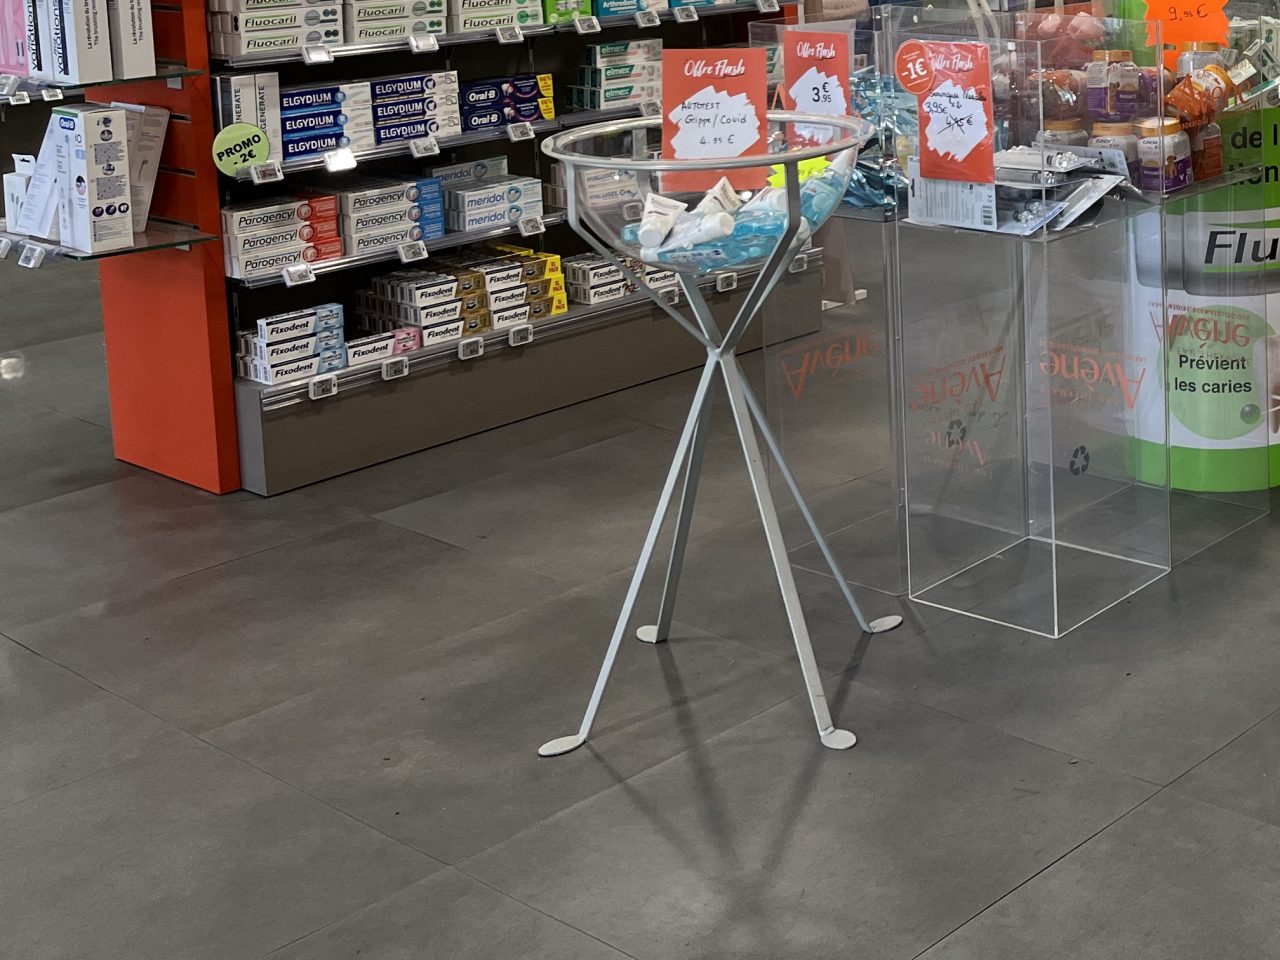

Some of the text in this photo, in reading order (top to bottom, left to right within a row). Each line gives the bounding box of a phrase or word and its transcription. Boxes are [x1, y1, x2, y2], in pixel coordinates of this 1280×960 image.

[684, 59, 746, 77] Offre Flash
[902, 58, 927, 80] -1€
[375, 80, 422, 95] ELGYDIUM
[283, 93, 332, 107] ELGYDIUM
[468, 90, 496, 102] Oral-B
[720, 114, 747, 125] Covid
[1231, 126, 1262, 150] de
[216, 133, 262, 162] PROMO
[467, 191, 506, 207] meridol
[238, 208, 295, 227] Parogencyl
[355, 210, 407, 228] Parogencyl
[489, 271, 522, 285] Fixodent
[270, 320, 309, 335] Fixodent
[275, 362, 313, 378] Fixodent
[1179, 354, 1246, 371] Prévient
[1174, 377, 1252, 393] les caries
